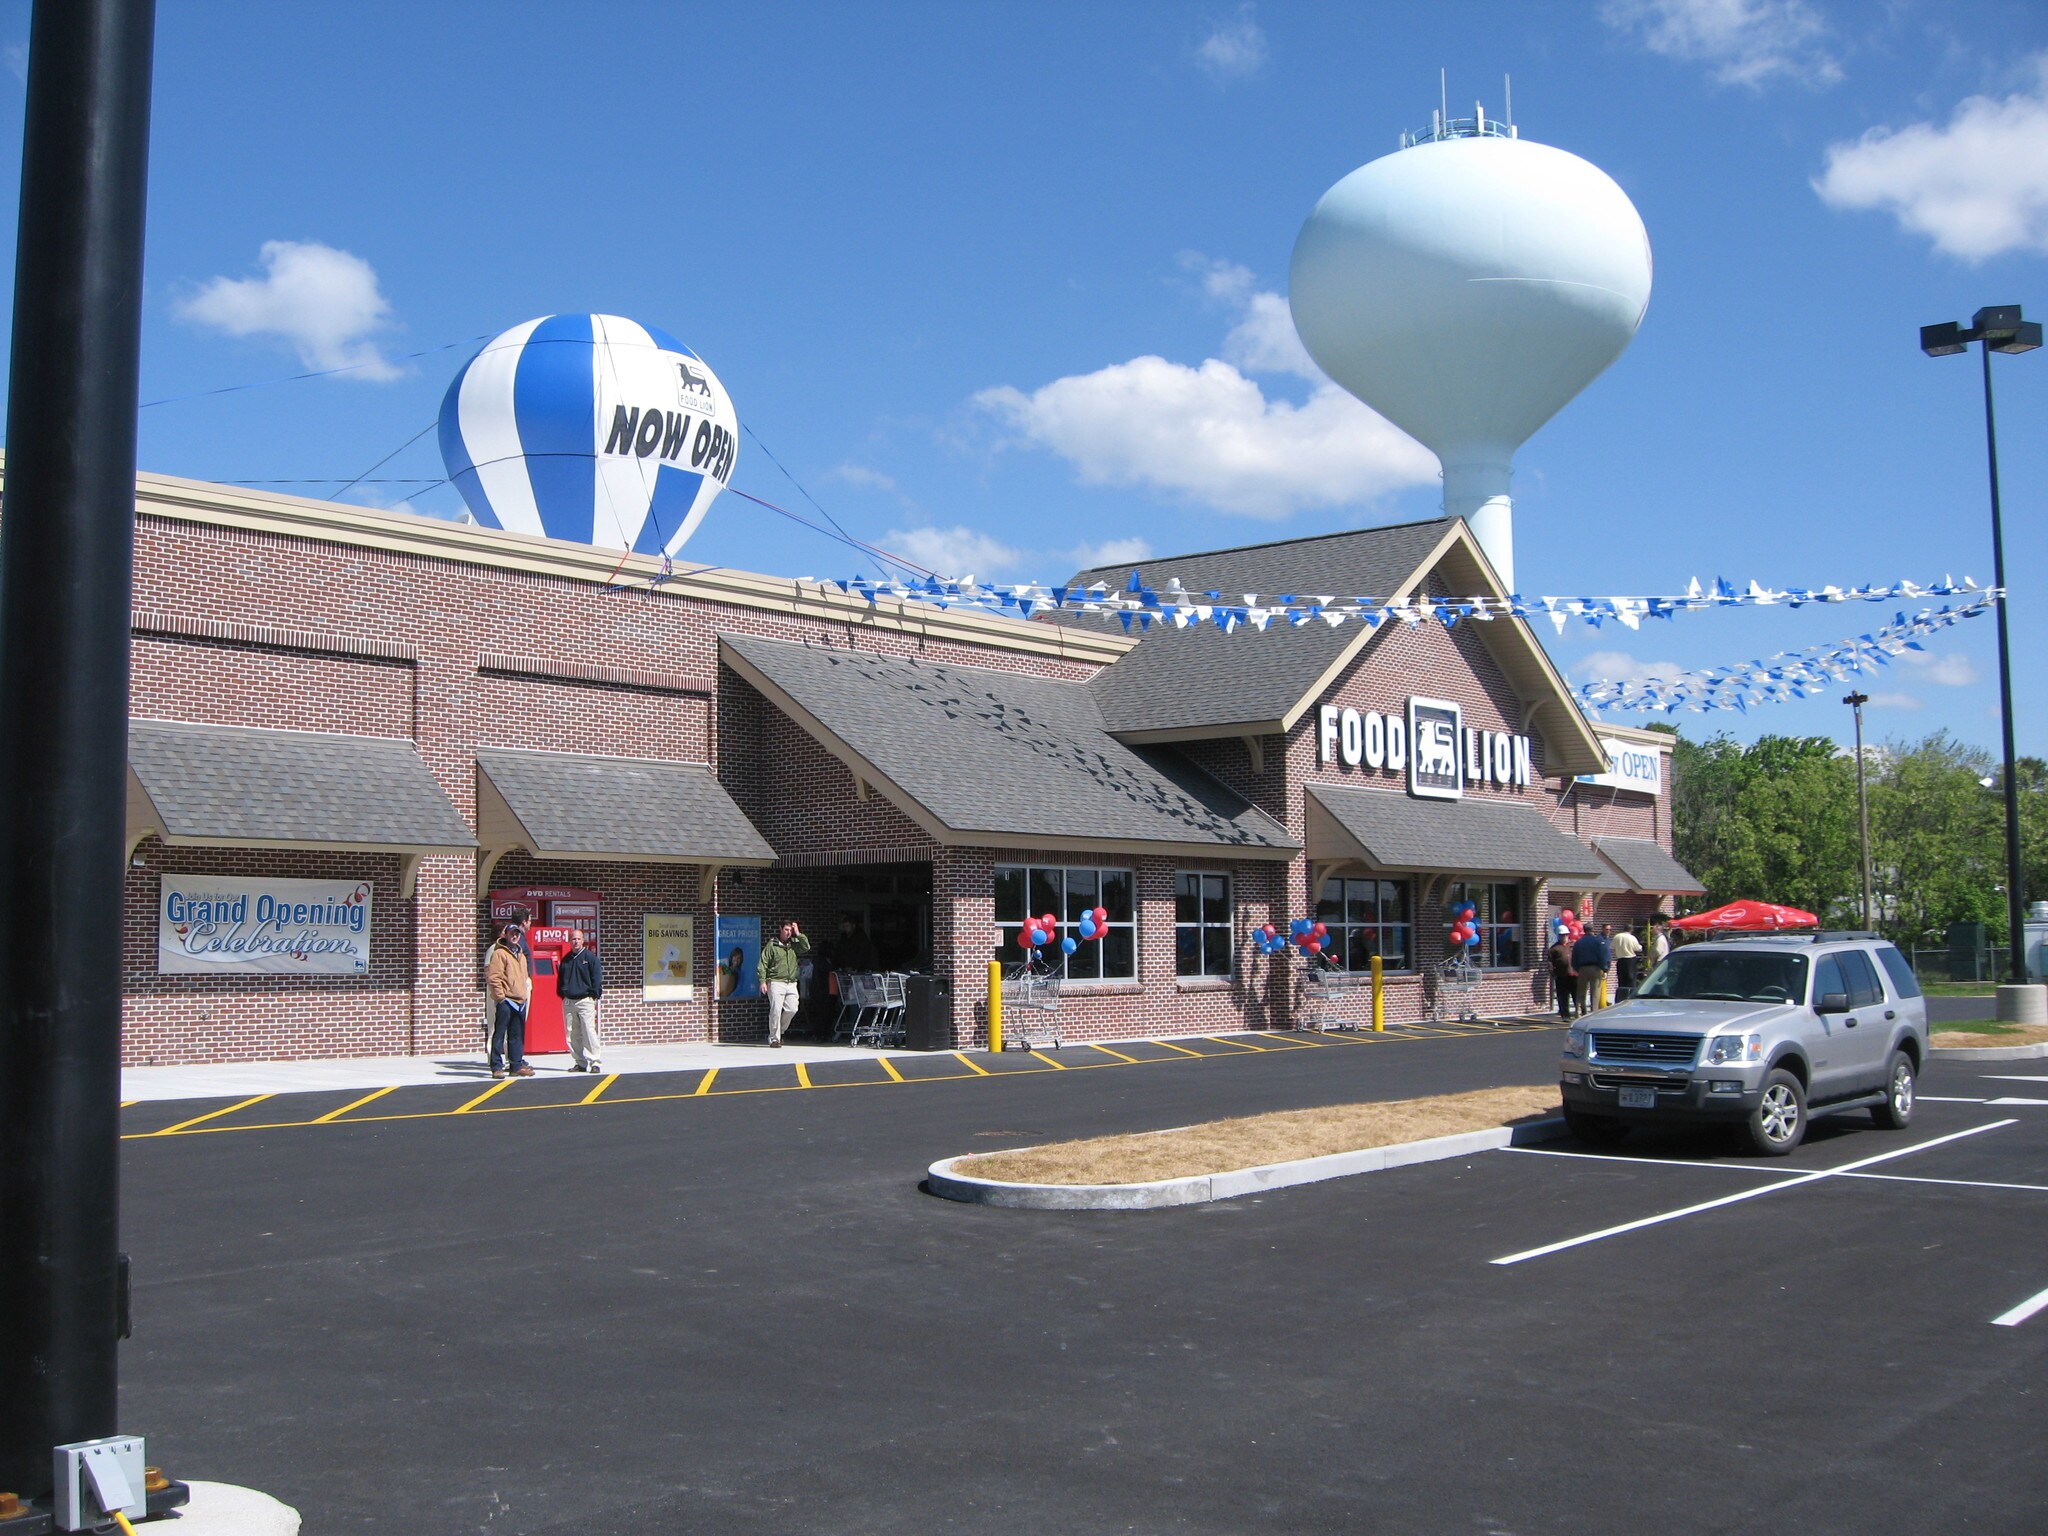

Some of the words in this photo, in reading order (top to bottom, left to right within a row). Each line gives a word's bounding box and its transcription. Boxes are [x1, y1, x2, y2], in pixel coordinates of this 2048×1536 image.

[680, 394, 698, 407] FOOD
[700, 401, 713, 412] LION
[604, 404, 691, 461] NOW
[691, 419, 735, 484] OPEN
[1317, 704, 1406, 770] FOOD
[1463, 727, 1531, 786] LION
[1622, 751, 1658, 781] OPEN
[544, 890, 571, 898] RENTALS
[167, 891, 248, 924] Grand
[256, 894, 365, 933] Opening
[184, 918, 357, 955] Celebration
[543, 930, 562, 938] DVD
[648, 929, 660, 938] BIG
